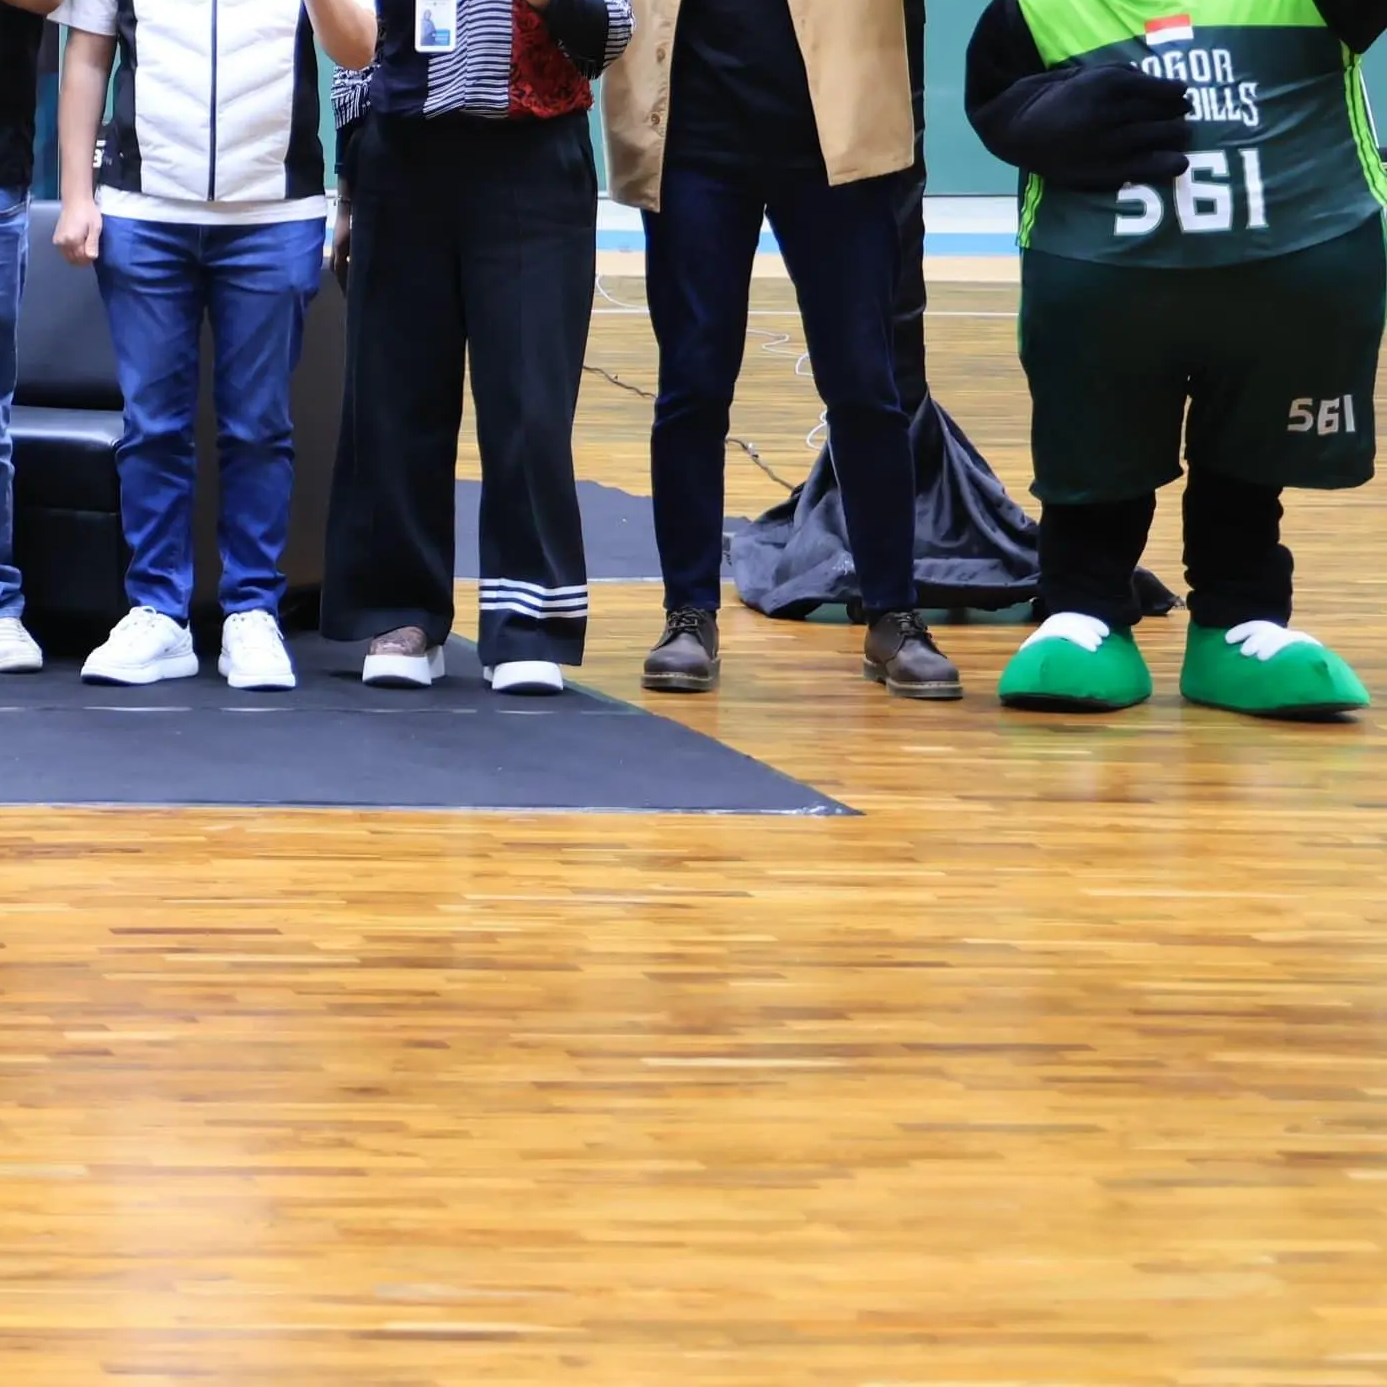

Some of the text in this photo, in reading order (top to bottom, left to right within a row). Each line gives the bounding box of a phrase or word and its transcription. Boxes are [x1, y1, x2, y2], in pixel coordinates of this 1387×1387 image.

[1131, 48, 1235, 82] OGOR
[1183, 82, 1260, 126] BILLS
[1114, 147, 1269, 236] 561
[1287, 394, 1356, 435] 561
